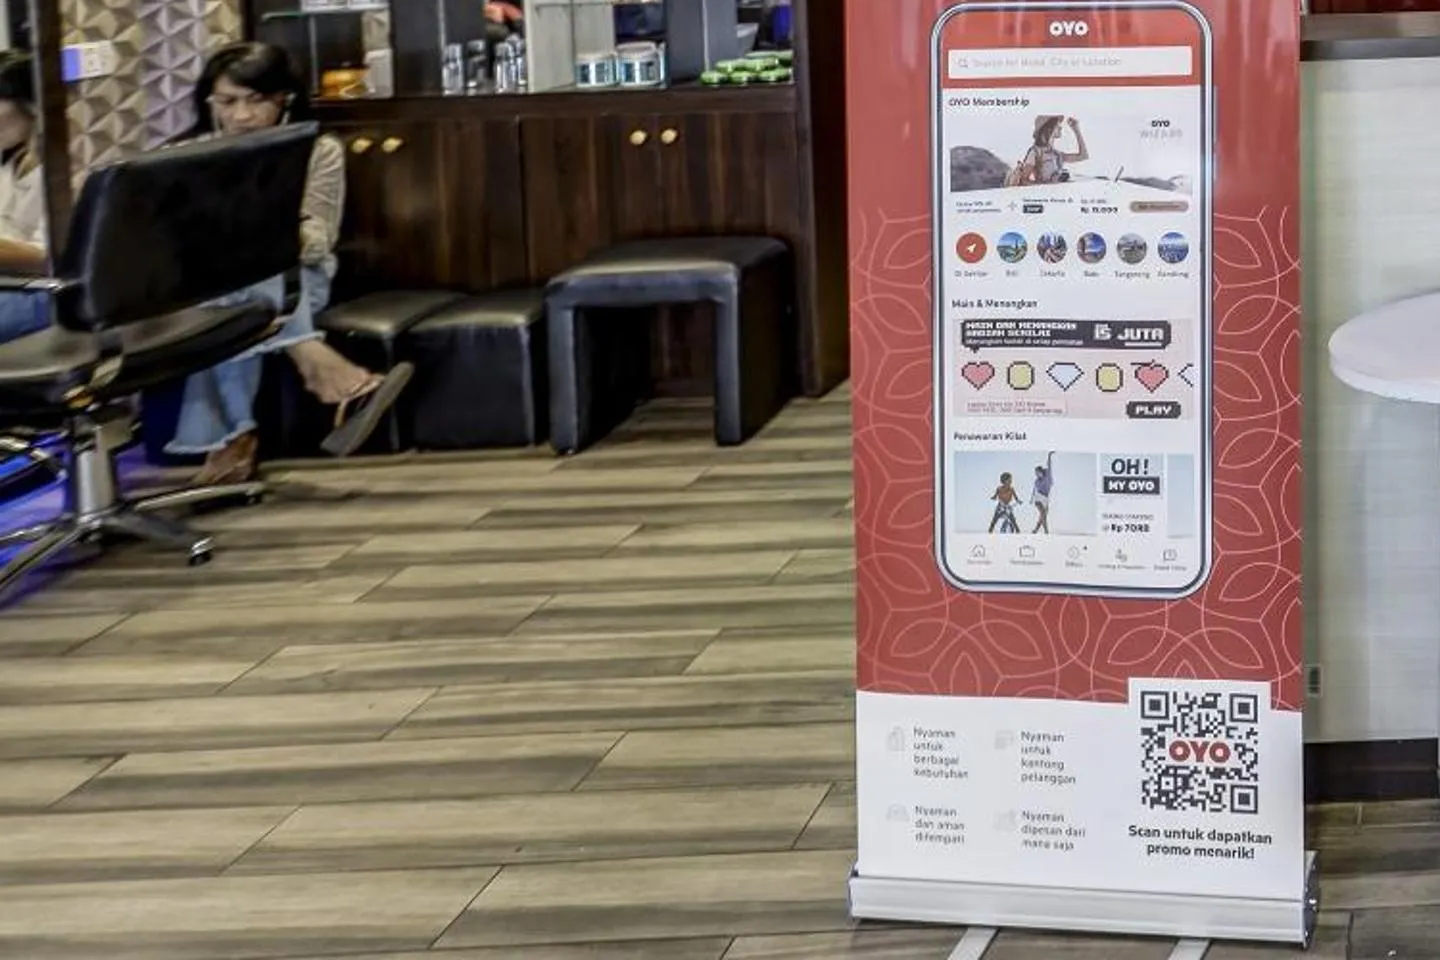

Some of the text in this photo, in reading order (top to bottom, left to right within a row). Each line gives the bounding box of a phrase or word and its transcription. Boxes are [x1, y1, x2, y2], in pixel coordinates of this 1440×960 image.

[1049, 20, 1089, 36] OYO
[948, 97, 1031, 108] OYO Membership
[951, 299, 1038, 310] Main & Menangkan
[1117, 327, 1165, 341] JUTA
[1135, 404, 1172, 416] PLAY
[953, 431, 1003, 441] Penawaran
[1111, 458, 1149, 475] OH!
[1108, 480, 1155, 491] MY OYO
[913, 727, 956, 738] Nyaman
[1020, 730, 1065, 743] Nyaman
[913, 741, 943, 751] untuk
[1020, 744, 1051, 755] untuk
[1168, 740, 1232, 763] OYO
[913, 754, 960, 766] berbagai
[1020, 758, 1065, 772] kantong
[1020, 772, 1077, 786] pelanggan
[914, 805, 957, 817] Nyaman
[1021, 810, 1065, 822] Nyaman
[914, 819, 965, 830] dan aman
[1020, 825, 1086, 837] dipesan dari
[1128, 824, 1273, 845] Scan untuk dapatkan
[1053, 840, 1075, 852] saja
[1146, 843, 1255, 859] promo menarik!
